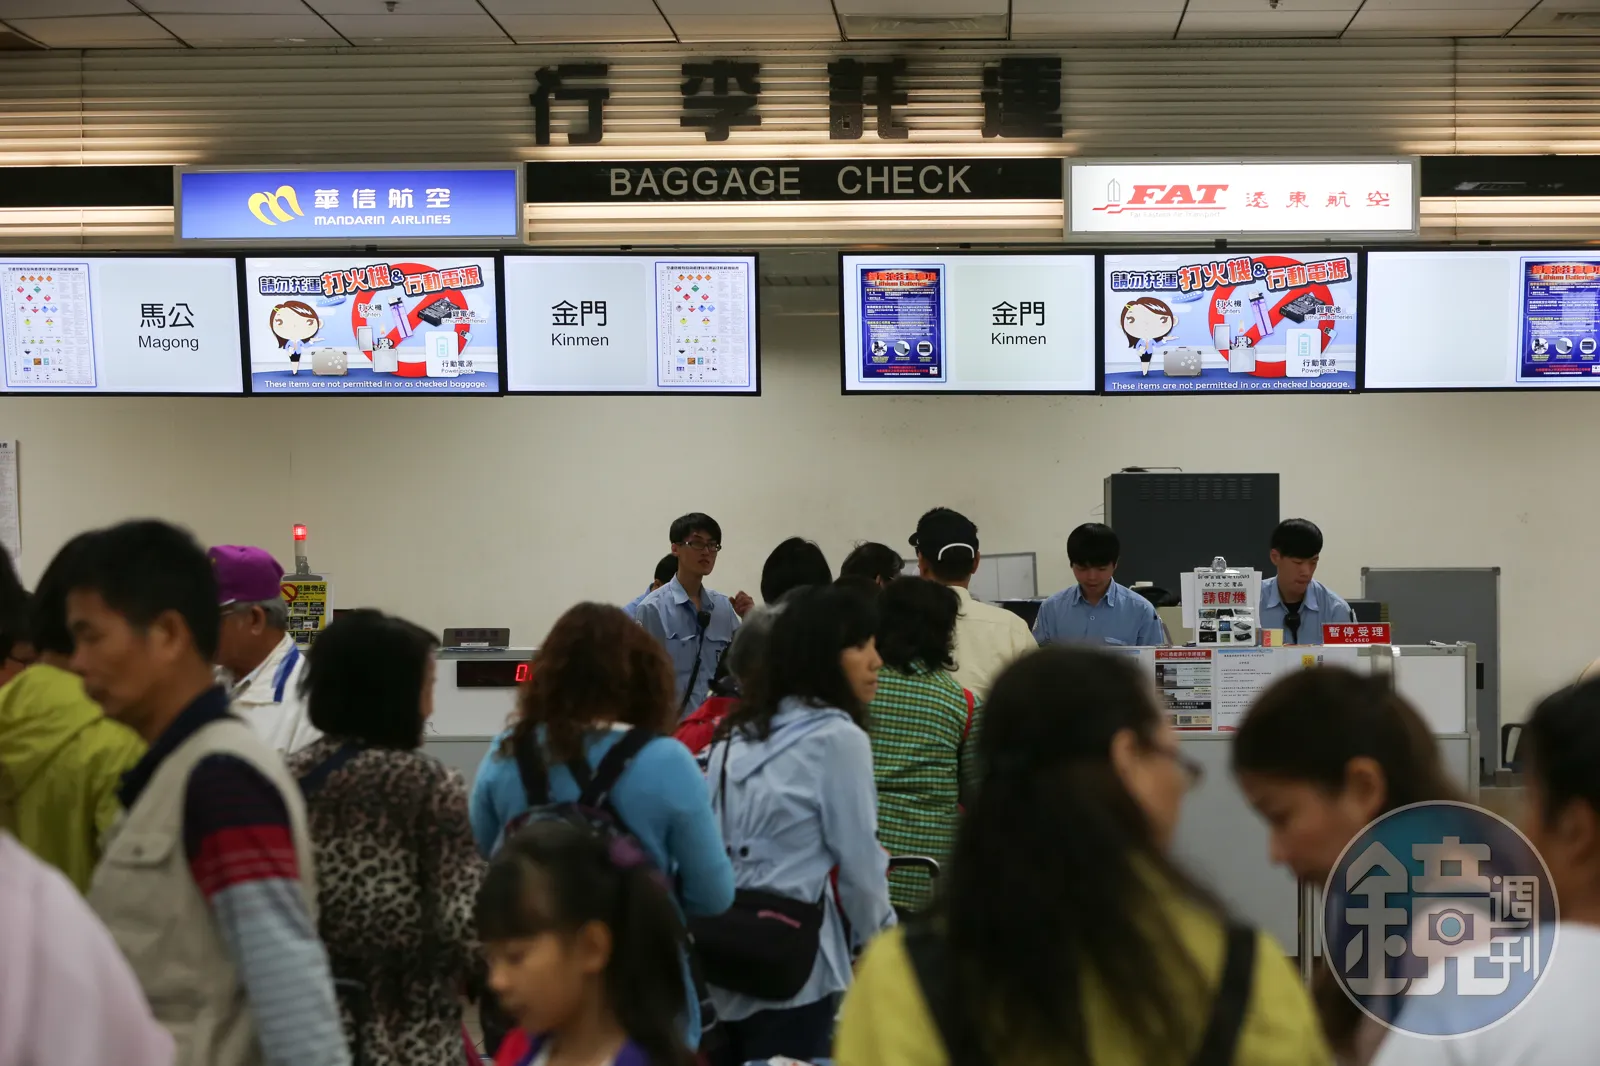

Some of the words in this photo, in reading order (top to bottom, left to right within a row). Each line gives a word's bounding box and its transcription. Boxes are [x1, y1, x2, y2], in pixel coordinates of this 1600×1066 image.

[530, 57, 1063, 145] 行李託運
[610, 166, 801, 197] BAGGAGE
[837, 164, 972, 195] CHECK
[314, 187, 451, 209] 華信航空
[1126, 184, 1229, 205] FAT
[1245, 190, 1391, 208] 遠東航空
[314, 214, 385, 226] MANDARIN
[391, 213, 451, 225] AIRLINES
[1217, 300, 1242, 308] 打火機
[140, 303, 195, 329] 馬公
[551, 300, 607, 327] 金門
[992, 301, 1045, 326] 金門
[138, 335, 199, 351] Magong
[551, 333, 609, 346] Kinmen
[991, 332, 1046, 345] Kinmen
[1303, 359, 1336, 367] 行動電源
[265, 380, 287, 388] These
[288, 380, 310, 388] items
[343, 380, 383, 390] permitted
[385, 380, 392, 388] in
[415, 380, 448, 388] checked
[450, 380, 488, 390] baggage.
[1112, 382, 1135, 390] These
[1137, 382, 1161, 390] items
[1179, 382, 1193, 390] not
[1195, 381, 1238, 390] permitted
[1240, 381, 1248, 389] in
[1310, 380, 1350, 390] baggage.
[1202, 591, 1247, 605] 請關機
[1328, 626, 1384, 637] 暫停受理
[515, 664, 532, 682] 0
